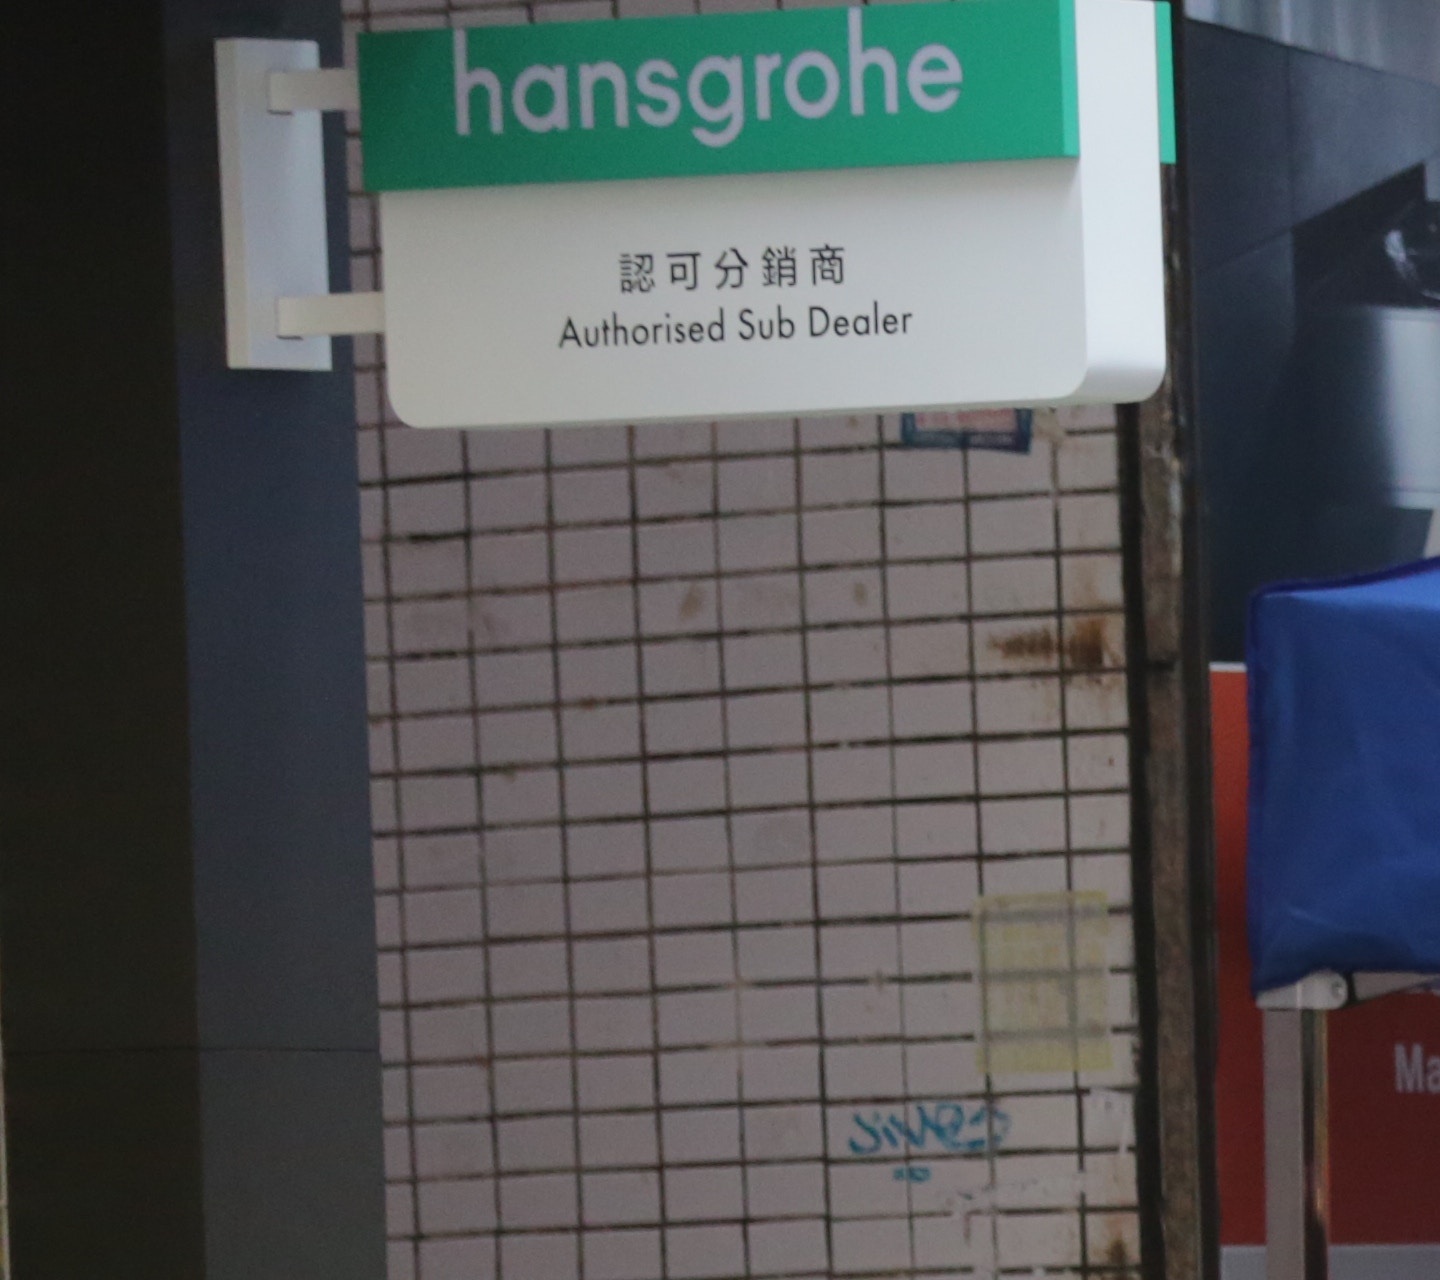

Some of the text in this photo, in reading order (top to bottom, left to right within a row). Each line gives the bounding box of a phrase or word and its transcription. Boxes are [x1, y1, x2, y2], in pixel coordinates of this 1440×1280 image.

[454, 7, 964, 148] hansgrohe
[617, 244, 847, 293] 認可分銷商
[557, 304, 914, 351] Authorised Sub Dealer
